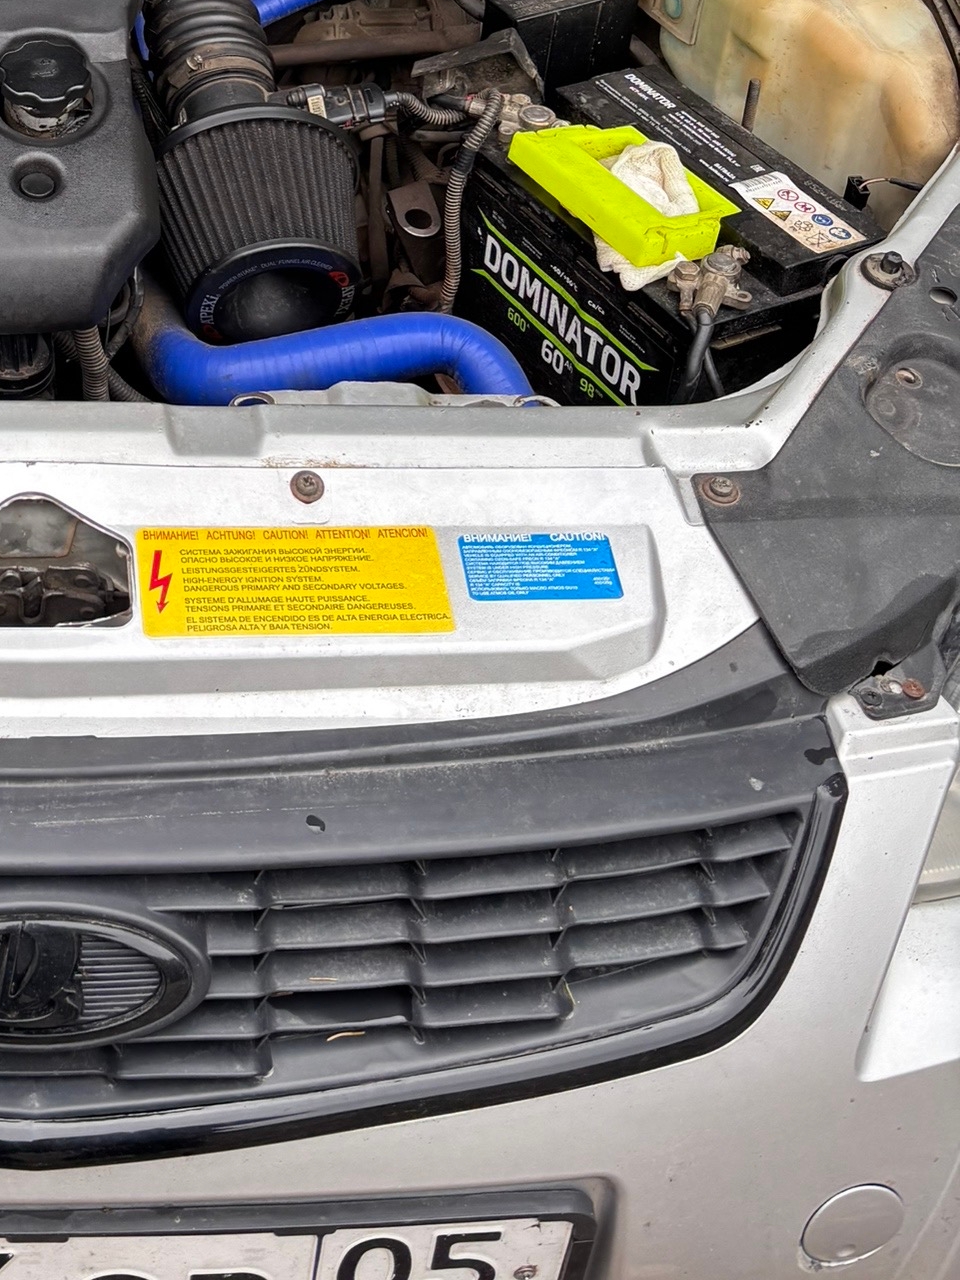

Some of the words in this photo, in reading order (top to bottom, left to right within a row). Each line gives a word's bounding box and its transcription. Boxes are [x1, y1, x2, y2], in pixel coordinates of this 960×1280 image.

[624, 73, 677, 110] DOMINATOR
[484, 234, 642, 406] DOMINATOR
[143, 530, 199, 540] ВНИМАНИЕ!
[206, 530, 256, 540] ACHTUNG!
[263, 530, 308, 540] CAUTION!
[316, 529, 370, 540] ATTENTION!
[378, 528, 428, 538] ATENCION!
[463, 534, 532, 542] ВНИМАНИЕ!
[550, 532, 606, 542] CAUTION!
[179, 548, 222, 556] СИСТЕМА
[278, 547, 322, 555] ВЫСОКОЙ
[181, 566, 296, 574] LEISTUNGSGESTEIGERTES
[298, 565, 361, 573] ZÜNDSYSTEM.
[183, 576, 244, 584] HIGH-ENERGY
[184, 584, 240, 592] DANGEROUS
[359, 582, 407, 590] VOLTAGES.
[228, 596, 284, 604] D'ALLUMAGE
[232, 604, 272, 612] PRIMARE
[274, 604, 285, 612] ET
[348, 602, 416, 610] DANGEREUSES.
[186, 616, 197, 624] EL
[308, 614, 321, 622] ES
[323, 614, 334, 622] DE
[400, 612, 452, 620] ELECTRICA.
[187, 624, 238, 632] PELIGROSA
